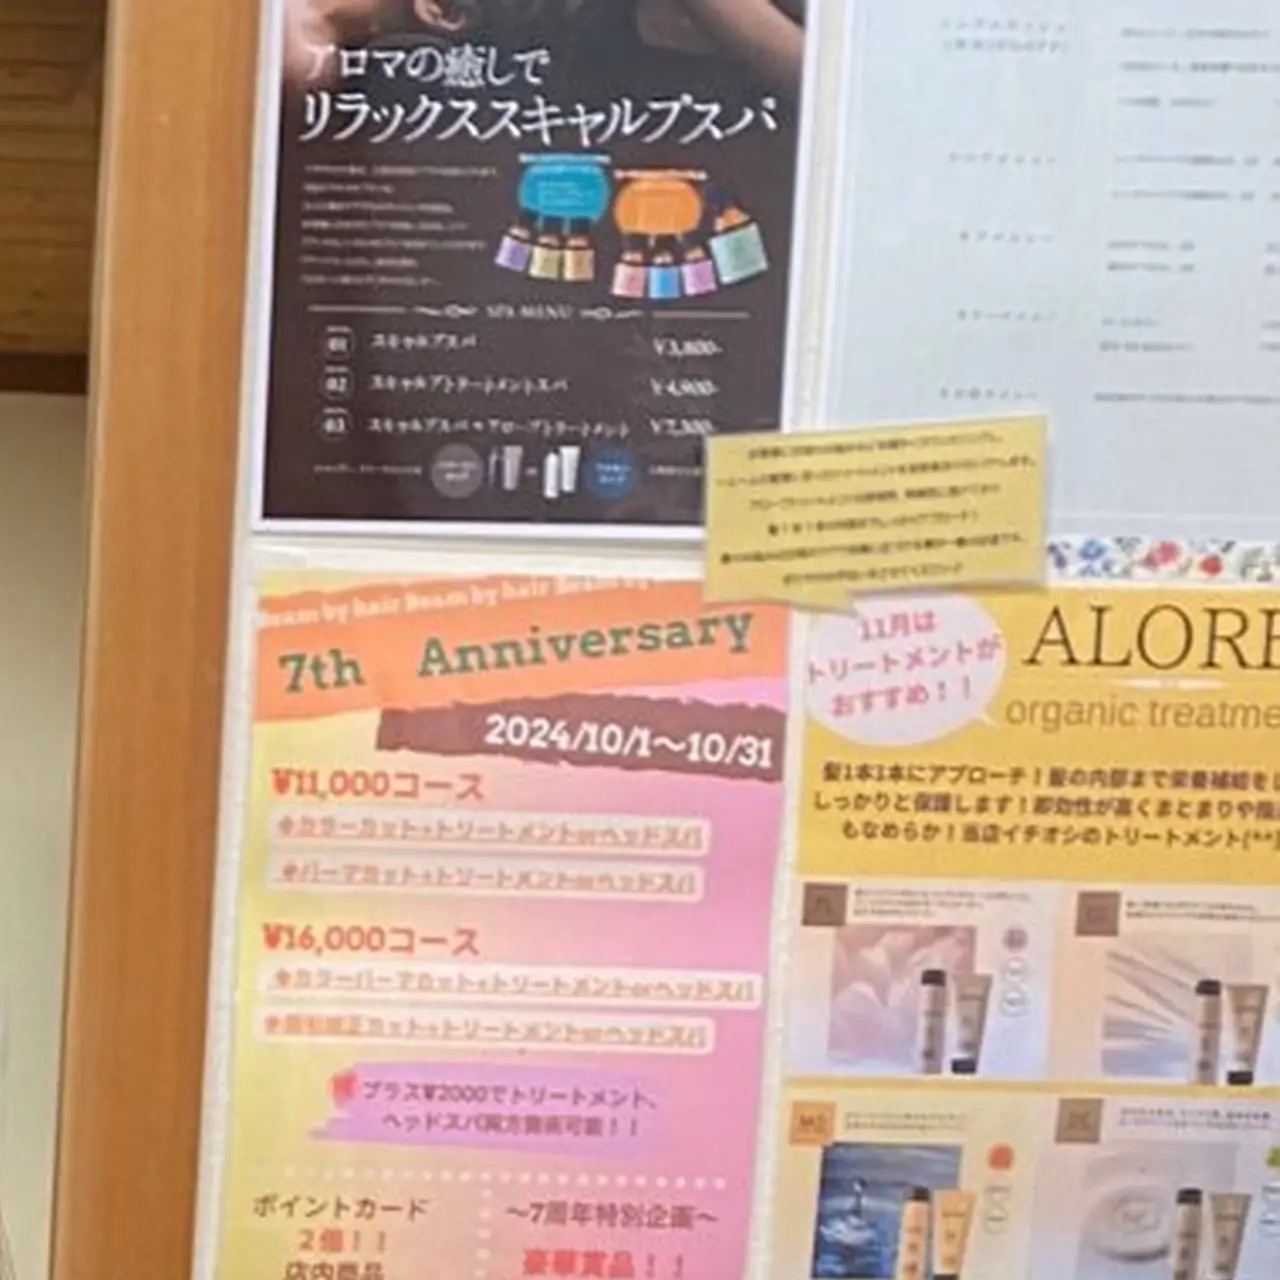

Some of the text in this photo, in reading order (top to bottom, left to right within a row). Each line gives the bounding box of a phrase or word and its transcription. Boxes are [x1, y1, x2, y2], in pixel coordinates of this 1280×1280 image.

[302, 44, 551, 89] アロマの癒しで
[298, 92, 779, 147] リラックススキャルプスパ
[859, 610, 938, 643] 11月は
[279, 611, 754, 693] 7th Anniversary
[807, 633, 1004, 686] トリートメントが
[1006, 695, 1139, 732] organic
[270, 767, 485, 800] ¥11,000コース
[263, 923, 481, 958] ¥16,000コース
[252, 1195, 429, 1223] ポイントカード
